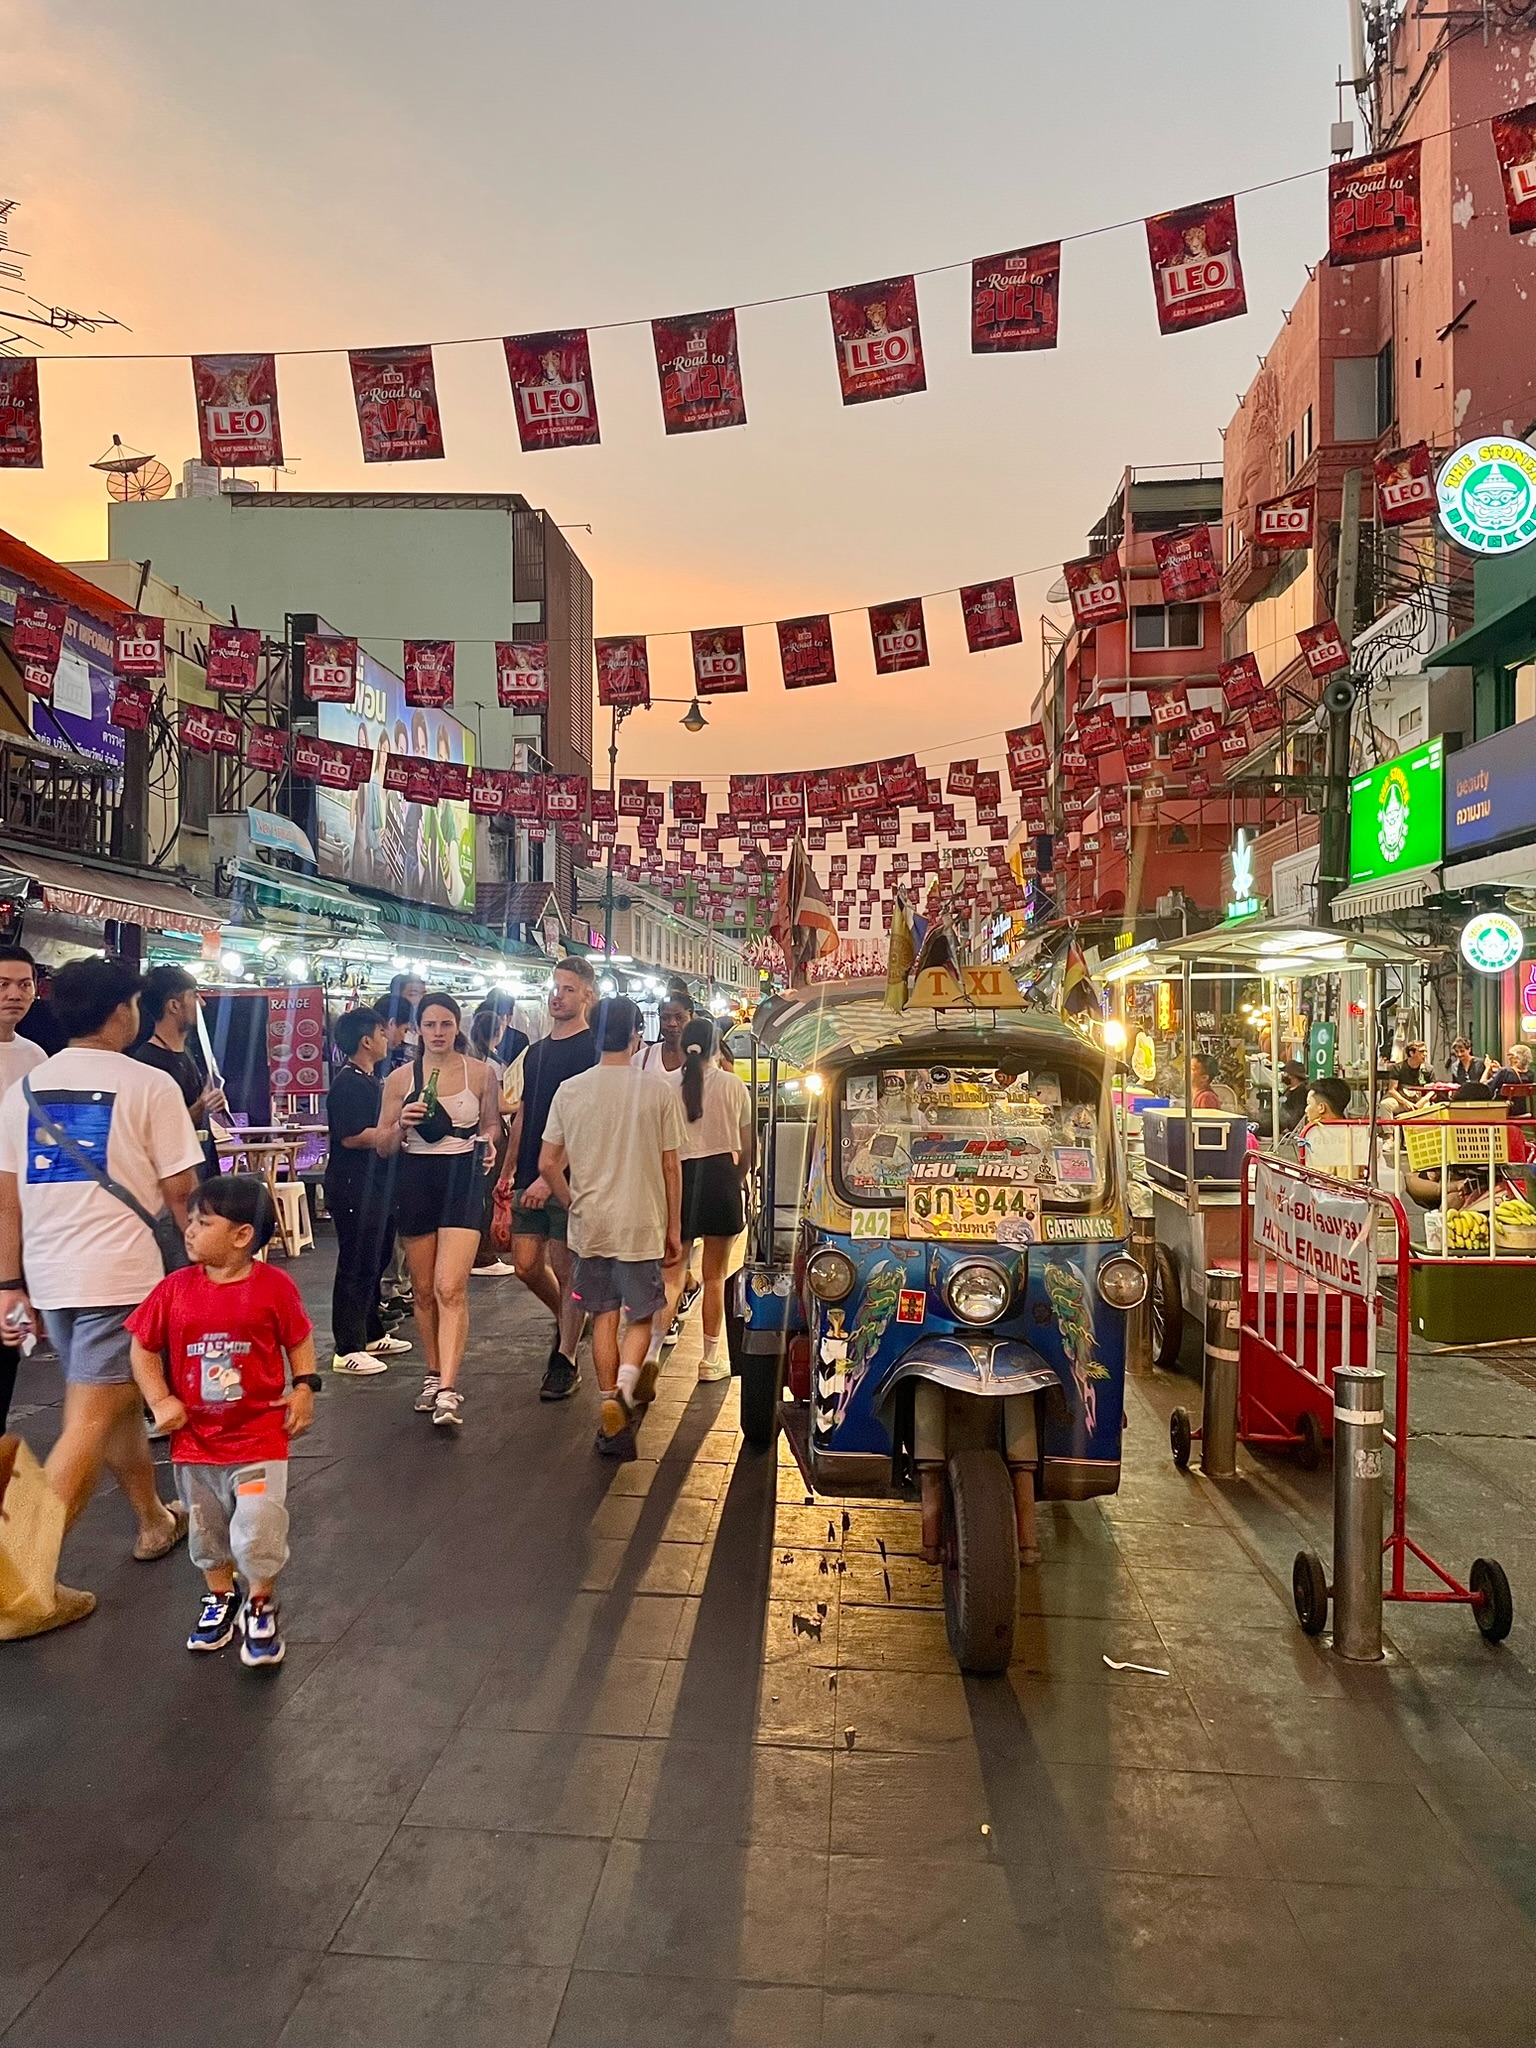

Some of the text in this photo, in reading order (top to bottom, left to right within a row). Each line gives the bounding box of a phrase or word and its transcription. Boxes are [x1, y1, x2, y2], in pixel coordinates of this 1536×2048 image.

[1345, 175, 1404, 200] Road to
[1334, 189, 1418, 240] 2024
[1006, 259, 1025, 269] LEO
[987, 272, 1044, 291] Road to
[1168, 260, 1227, 298] LEO
[977, 285, 1054, 328] 2024
[688, 340, 705, 351] LEO
[851, 335, 908, 370] LEO
[673, 351, 725, 373] Road to
[665, 364, 740, 409] 2024
[369, 385, 422, 405] Road to
[528, 388, 582, 417] LEO
[212, 409, 267, 436] LEO
[362, 399, 439, 438] 2024
[1444, 454, 1476, 489] THE
[1387, 482, 1424, 504] LEO
[1265, 511, 1304, 530] LEO
[1446, 504, 1536, 548] BANGKO
[1165, 550, 1203, 568] Road to
[1079, 586, 1116, 608] LEO
[973, 600, 1008, 614] Road to
[22, 617, 47, 630] Road
[47, 623, 57, 631] to
[790, 639, 823, 652] Road to
[882, 634, 918, 653] LEO
[123, 643, 156, 658] LEO
[218, 647, 249, 659] Road to
[1311, 643, 1338, 660] LEO
[412, 661, 448, 672] Road to
[605, 659, 639, 671] Road to
[701, 658, 737, 676] LEO
[26, 667, 49, 684] LEO
[313, 669, 347, 684] LEO
[505, 673, 541, 688] LEO
[1156, 704, 1184, 721] LEO
[189, 723, 211, 742] LEO
[1191, 723, 1215, 738] LEO
[1223, 738, 1244, 749] LEO
[299, 752, 318, 765] LEO
[1014, 747, 1041, 763] LEO
[1064, 754, 1085, 766] LEO
[323, 762, 348, 778] LEO
[388, 771, 407, 782] LEO
[952, 774, 972, 786] LEO
[475, 791, 500, 803] LEO
[850, 786, 874, 799] LEO
[1145, 787, 1163, 797] LEO
[549, 797, 574, 809] LEO
[622, 796, 643, 807] LEO
[774, 795, 800, 807] LEO
[1064, 801, 1081, 811] LEO
[648, 807, 661, 816] EO
[979, 810, 995, 819] LEO
[1104, 813, 1120, 822] LEO
[681, 823, 698, 832] LEO
[752, 824, 767, 833] LEO
[881, 820, 897, 829] LEO
[529, 829, 544, 837] LEO
[599, 834, 614, 842] LEO
[880, 835, 895, 843] LEO
[741, 838, 755, 846] LEO
[810, 836, 825, 845] LEO
[1084, 842, 1099, 852] LEO
[587, 849, 601, 857] LEO
[648, 854, 662, 862] LEO
[1023, 850, 1037, 858] LEO
[708, 860, 721, 869] LEO
[768, 859, 780, 867] LEO
[833, 863, 845, 871] LEO
[894, 860, 908, 869] LEO
[927, 970, 1003, 997] TXI
[974, 1188, 1027, 1218] 944
[853, 1211, 889, 1237] 242
